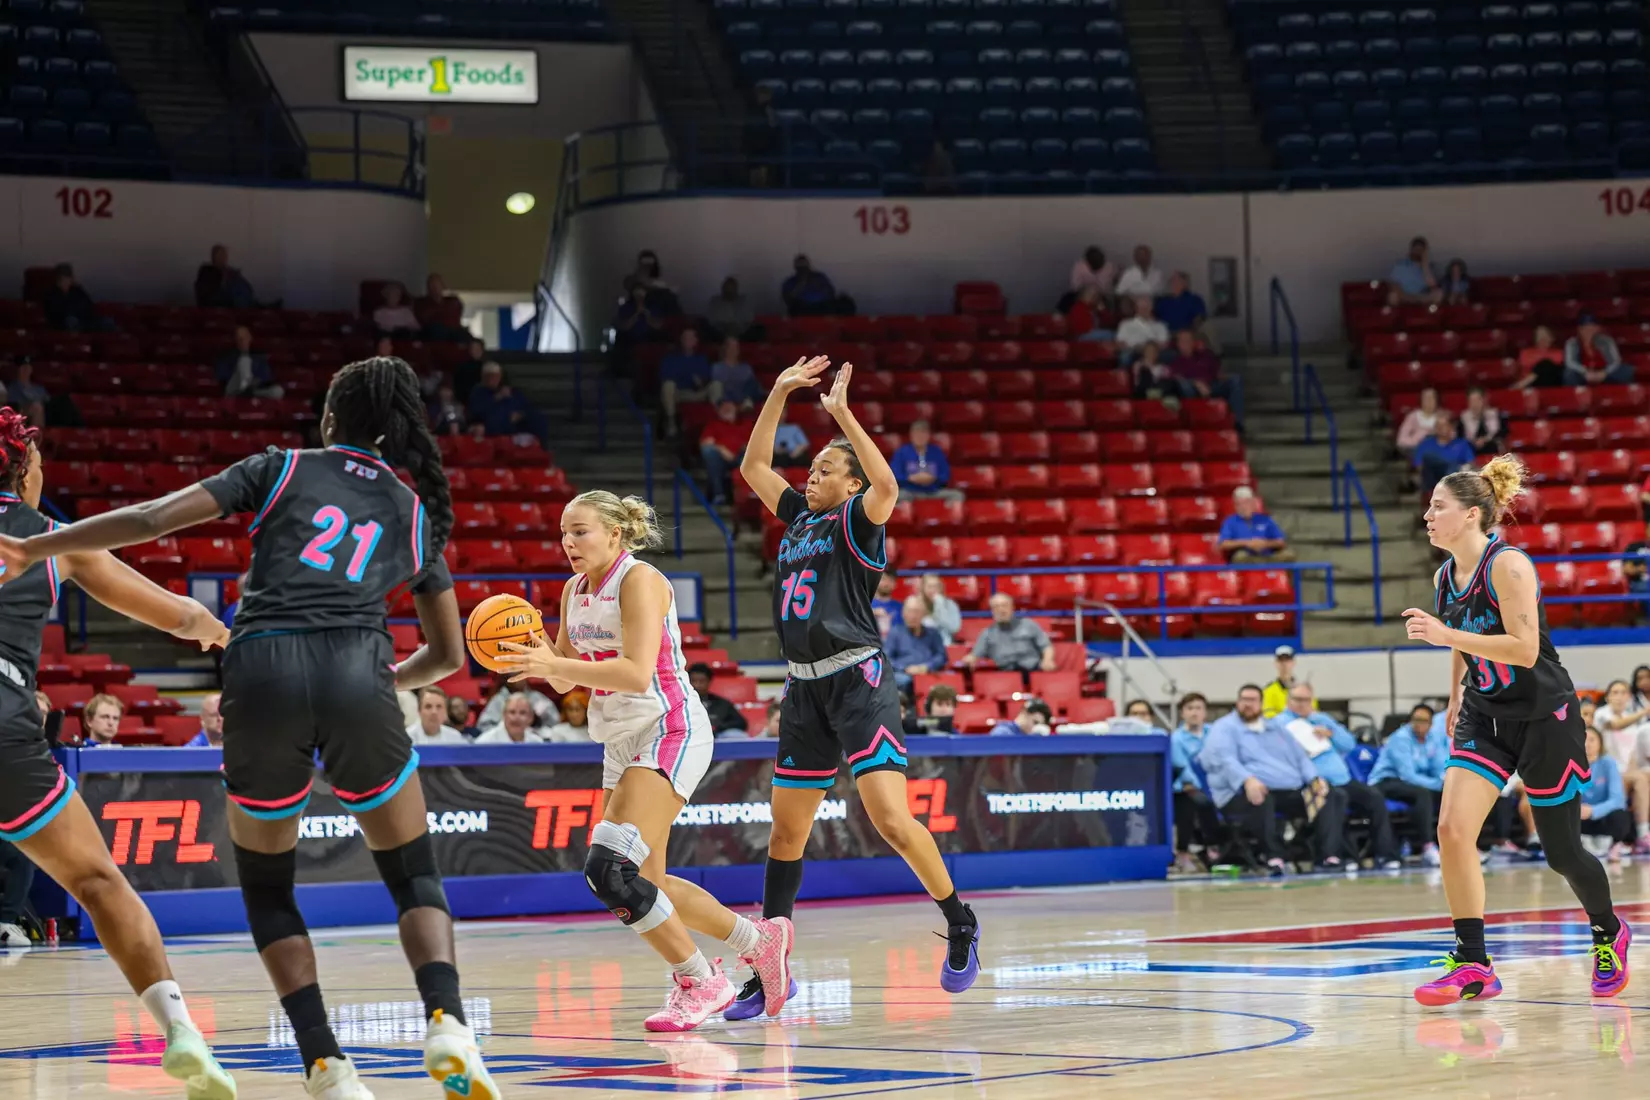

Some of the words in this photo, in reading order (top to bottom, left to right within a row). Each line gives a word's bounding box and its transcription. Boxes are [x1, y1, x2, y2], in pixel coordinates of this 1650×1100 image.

[356, 58, 426, 88] Super
[429, 56, 451, 94] 1
[453, 61, 525, 85] Foods
[55, 185, 113, 218] 102
[853, 205, 911, 235] 103
[344, 459, 378, 480] FIU
[299, 505, 384, 583] 21
[781, 569, 817, 621] 15
[906, 778, 958, 832] FL
[102, 800, 215, 865] TFL
